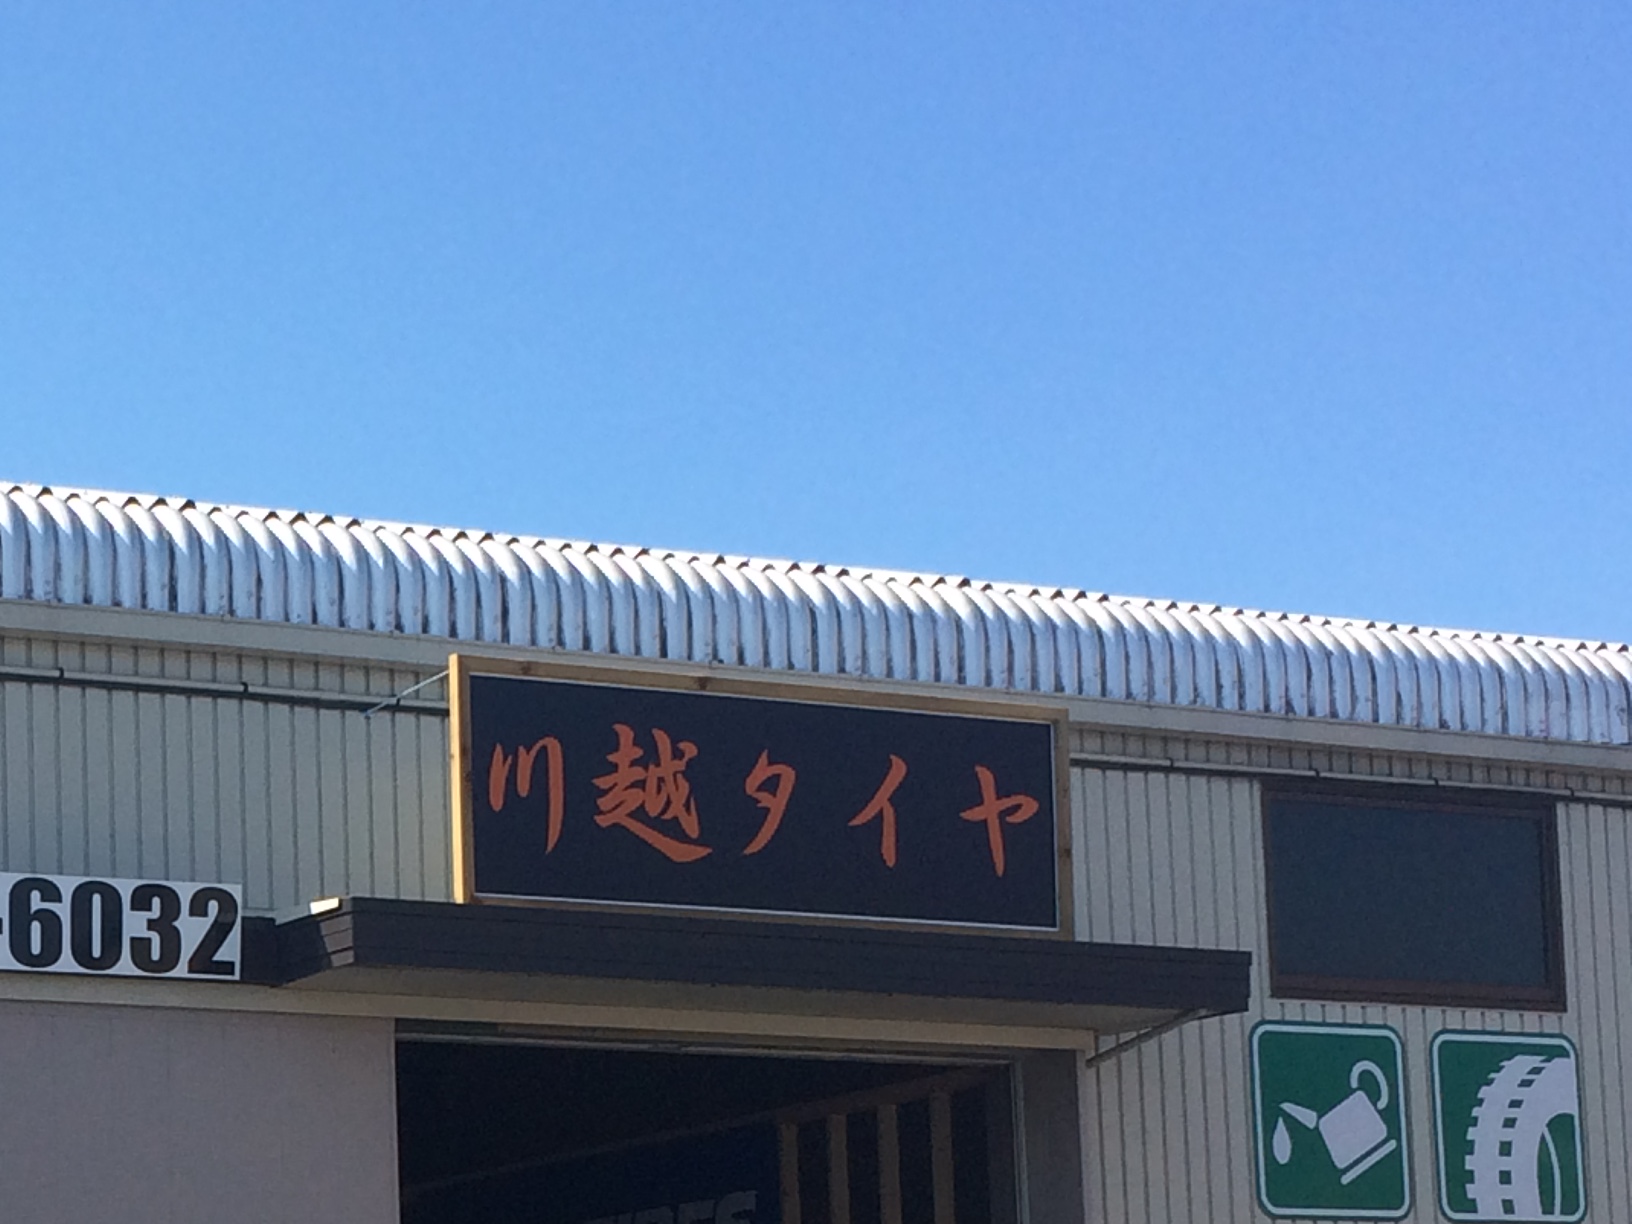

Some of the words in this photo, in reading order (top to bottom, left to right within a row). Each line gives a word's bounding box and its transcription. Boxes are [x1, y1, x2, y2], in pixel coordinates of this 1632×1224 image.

[489, 723, 1039, 877] 川越タイヤ
